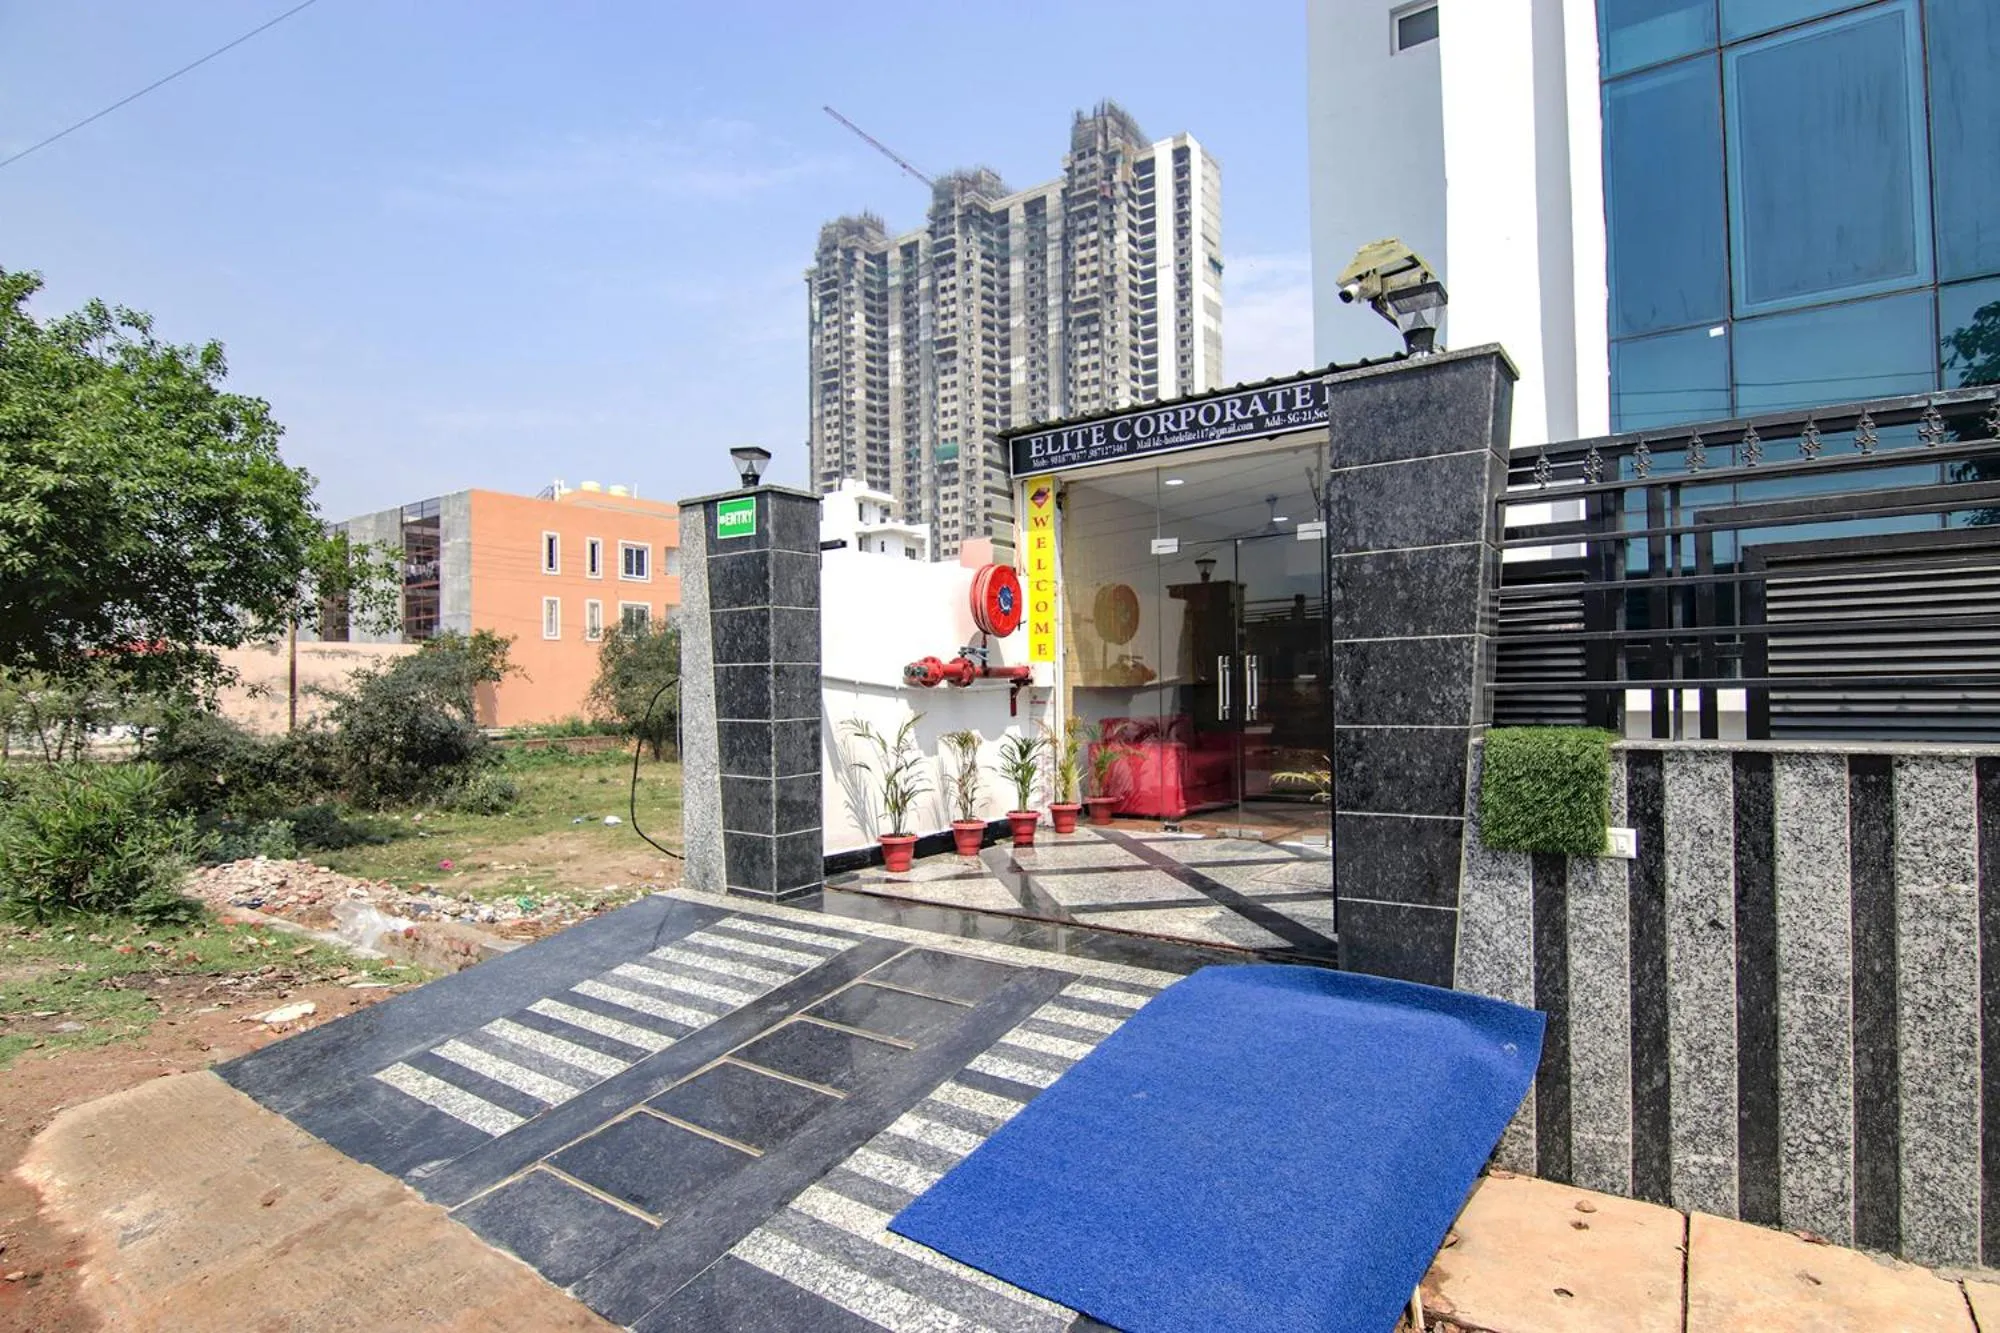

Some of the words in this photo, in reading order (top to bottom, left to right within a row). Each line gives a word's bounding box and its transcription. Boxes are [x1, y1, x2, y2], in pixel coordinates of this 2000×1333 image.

[1029, 426, 1107, 459] ELITE
[1113, 384, 1314, 442] CORPORATE
[725, 509, 753, 526] ENTRY
[1033, 516, 1050, 657] WELCOME
